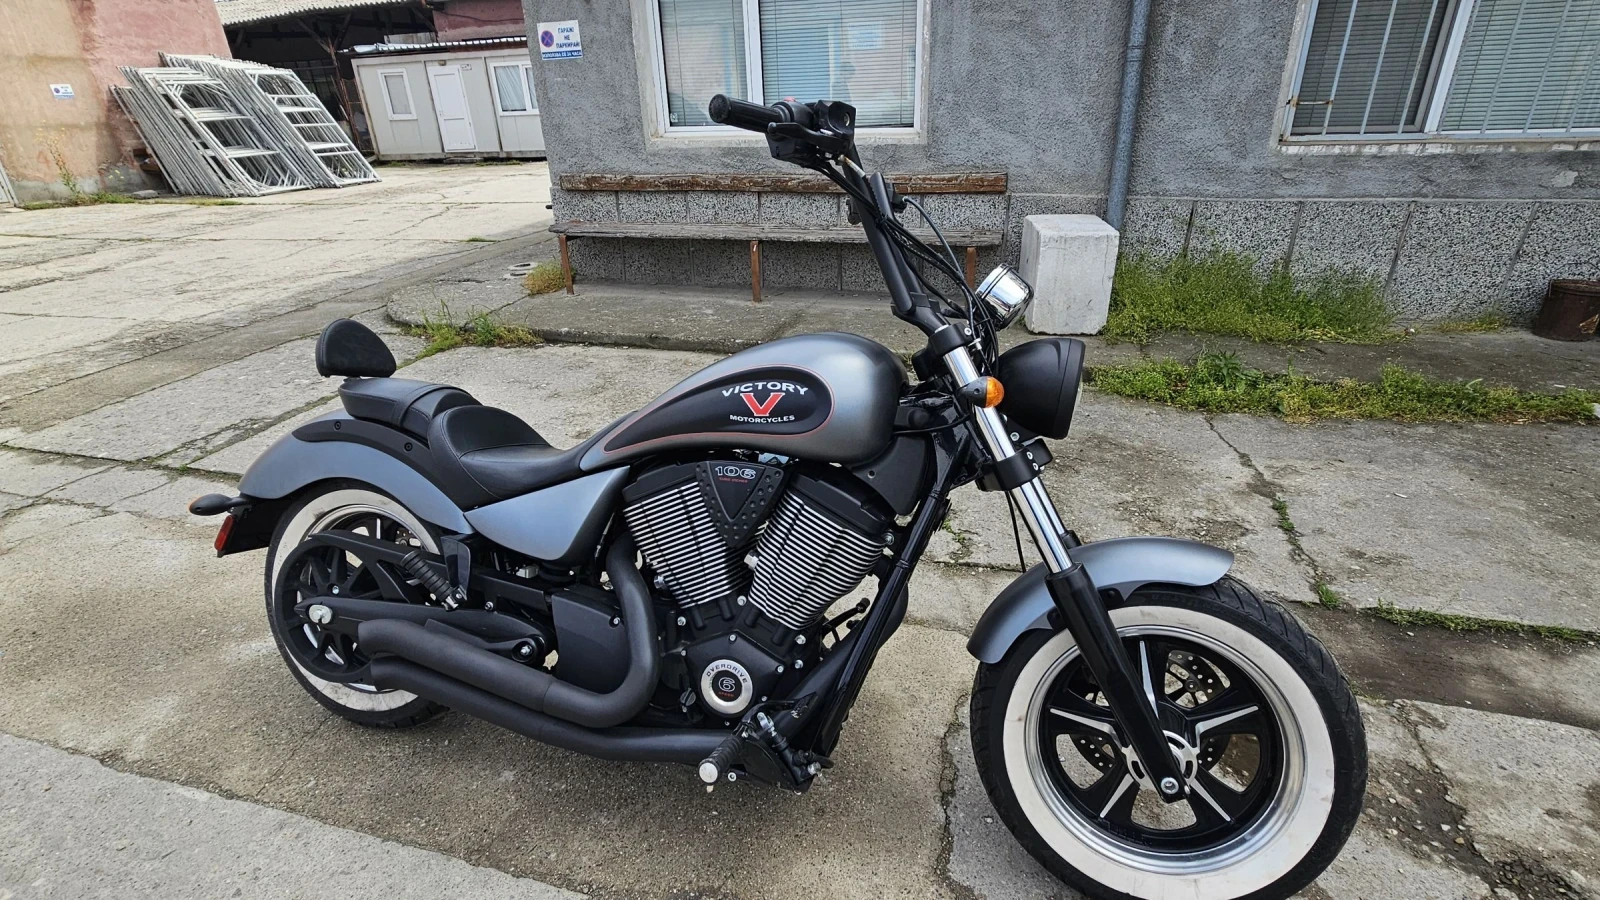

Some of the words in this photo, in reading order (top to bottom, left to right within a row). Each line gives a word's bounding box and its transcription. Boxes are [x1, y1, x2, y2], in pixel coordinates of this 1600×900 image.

[721, 381, 809, 397] VICTORY
[739, 392, 786, 417] V
[729, 414, 796, 424] MOTORCYCLES
[715, 466, 757, 480] 106
[706, 663, 748, 684] OVERDRIVE
[718, 677, 735, 692] 6
